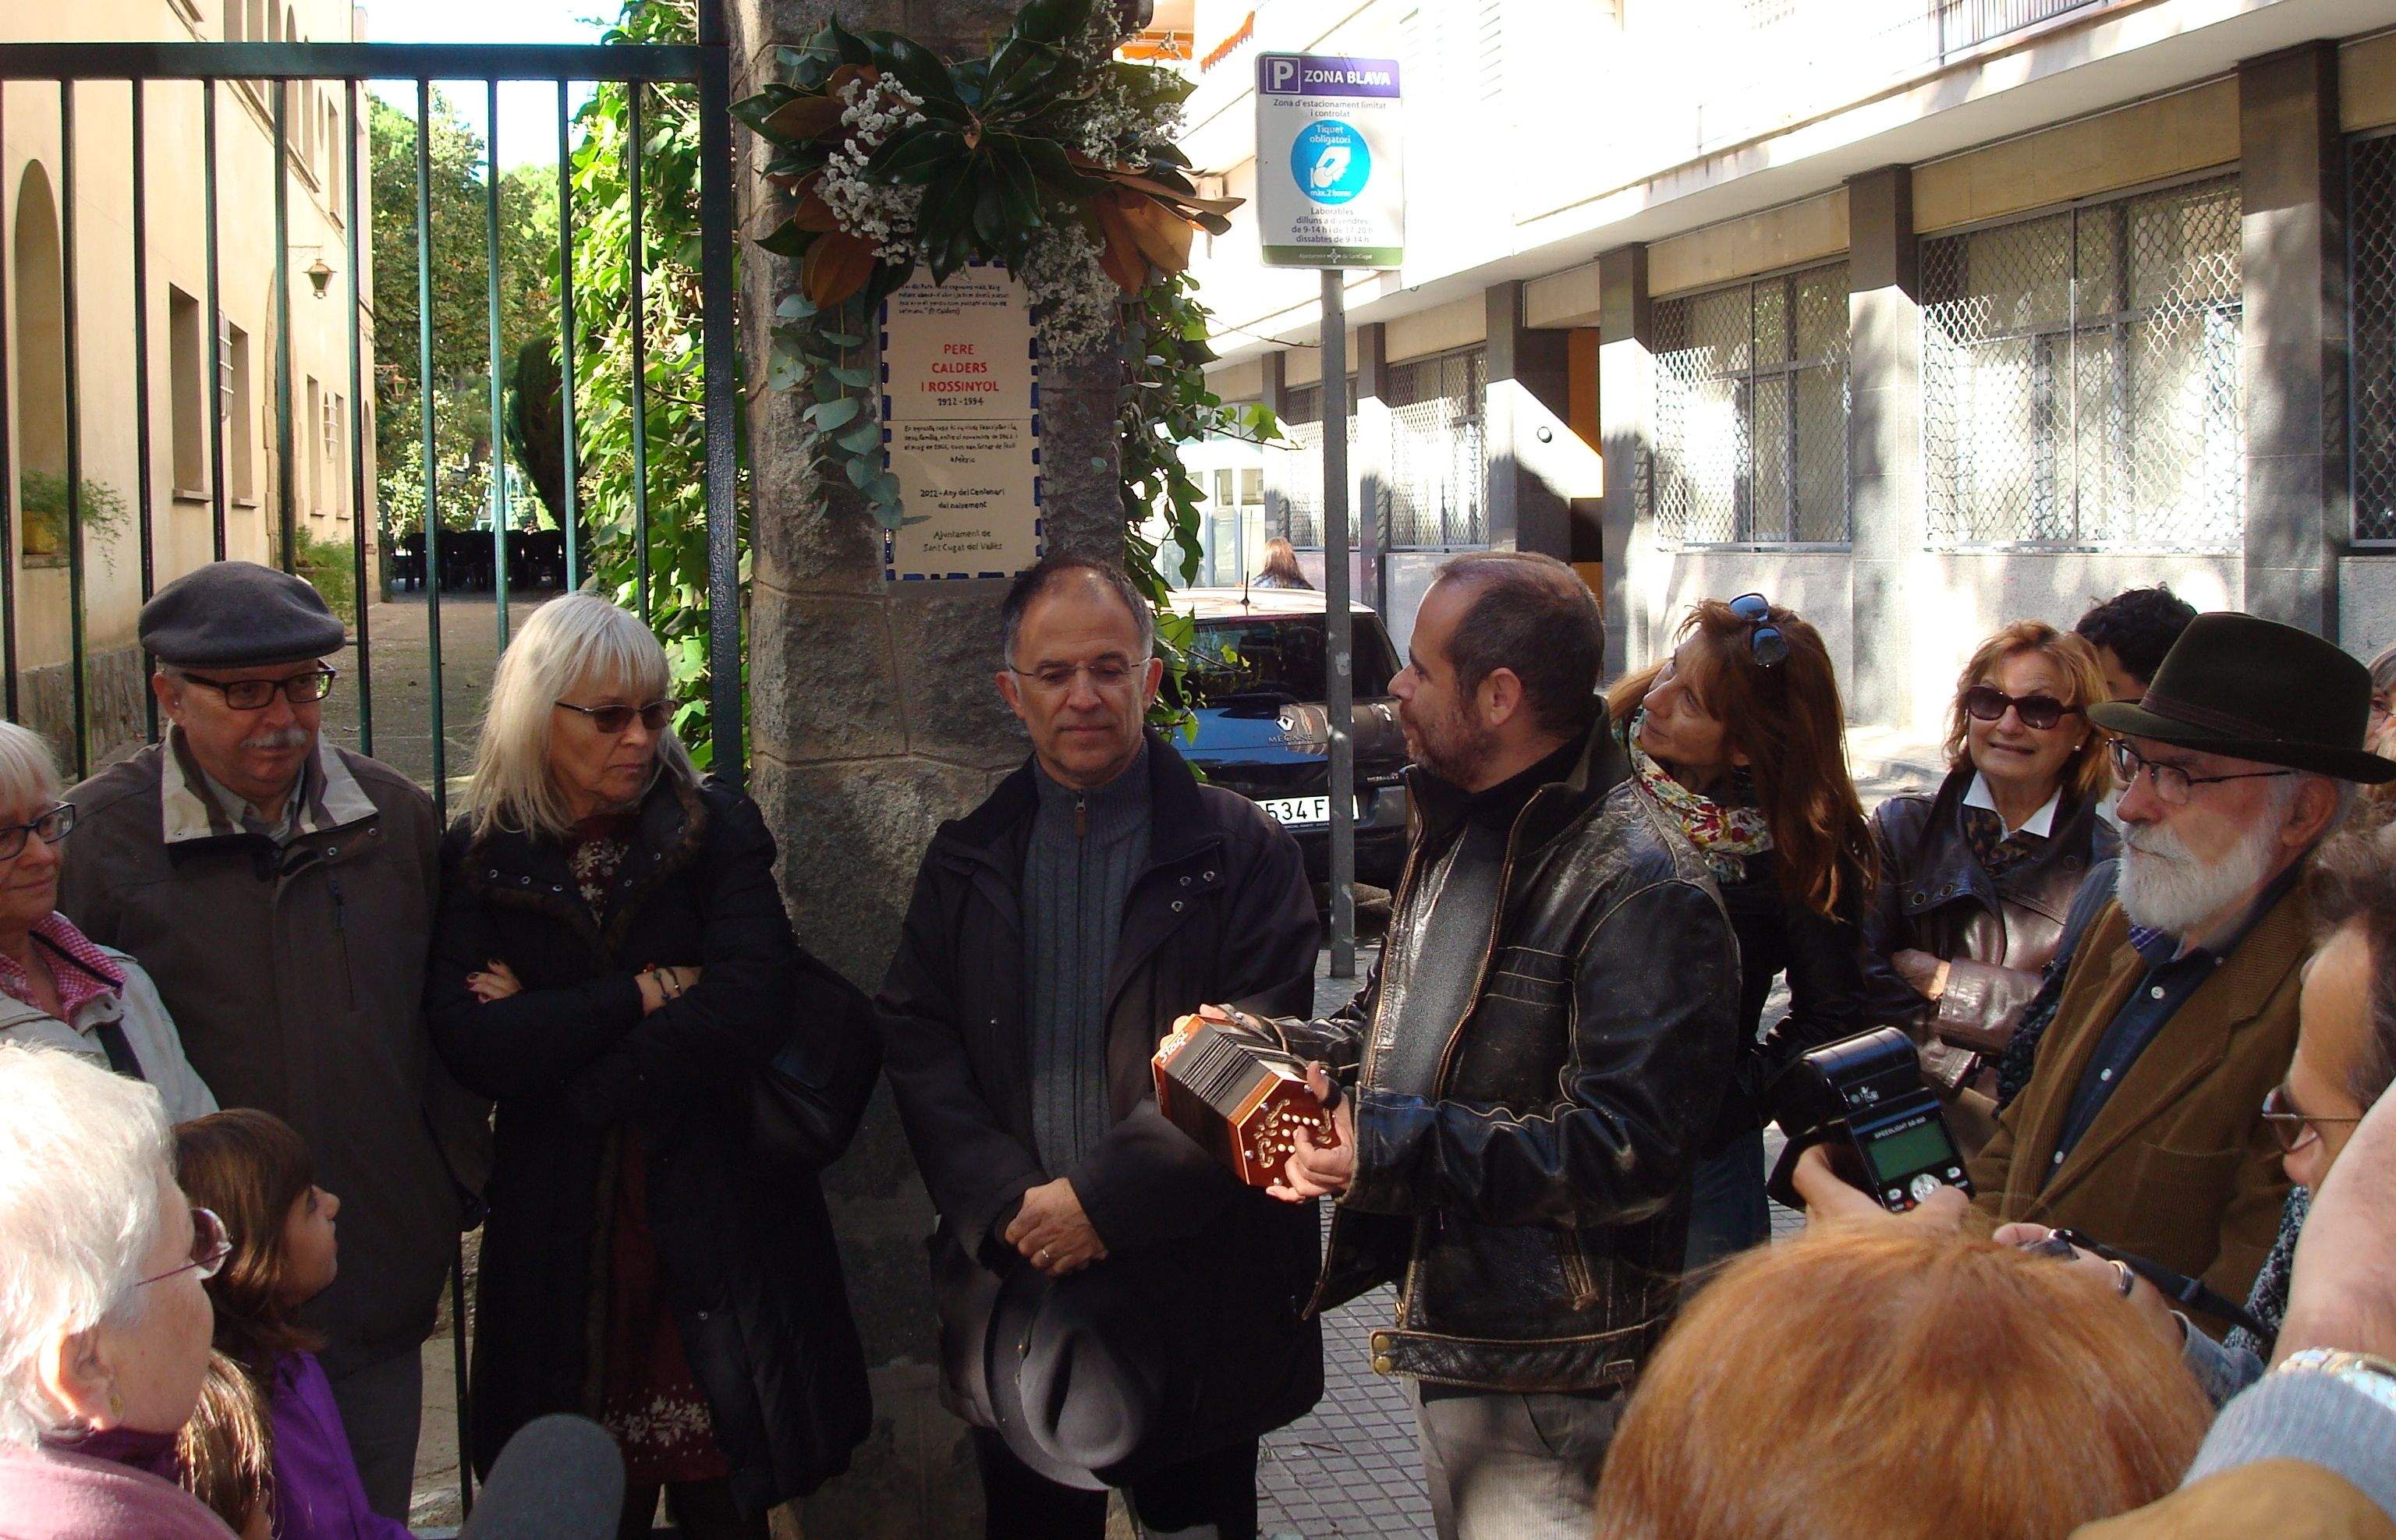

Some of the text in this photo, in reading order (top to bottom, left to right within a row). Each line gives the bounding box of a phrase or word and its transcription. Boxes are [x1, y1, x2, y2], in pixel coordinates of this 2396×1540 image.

[1273, 61, 1294, 89] P
[1304, 69, 1391, 85] ZONA BLAVA
[1295, 100, 1359, 109] d'estacionament
[1361, 101, 1386, 110] limitat
[1316, 125, 1344, 135] Tiquet
[1310, 135, 1351, 145] obligatori
[1310, 207, 1353, 215] Laborables
[1295, 235, 1332, 243] dissabtes
[944, 344, 974, 355] PERE
[931, 362, 987, 373] CALDERS
[921, 381, 1000, 392] I ROSSINYOL
[944, 489, 957, 499] Any
[970, 487, 1005, 496] Centenari
[934, 529, 980, 540] Ajuntament
[923, 543, 941, 552] Sant
[942, 543, 966, 554] Cugat
[966, 543, 980, 551] del
